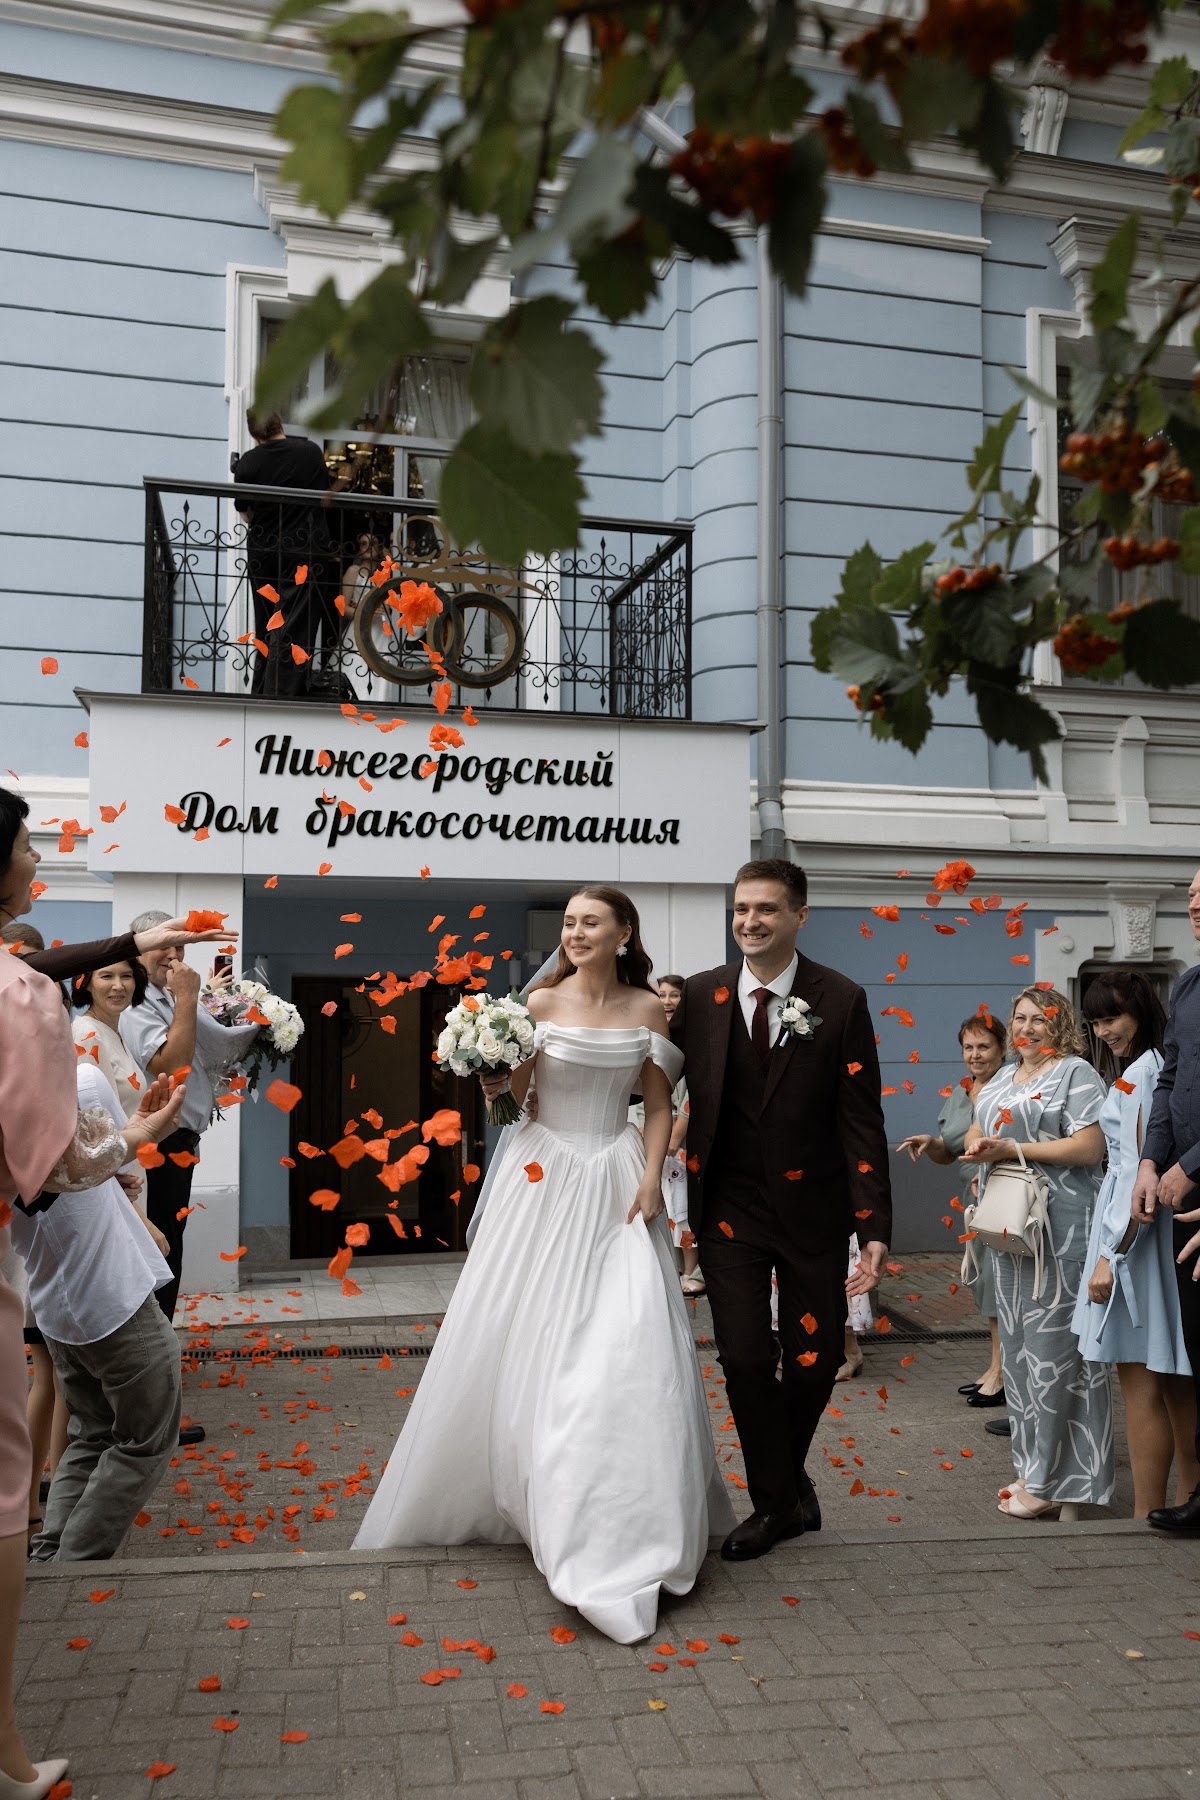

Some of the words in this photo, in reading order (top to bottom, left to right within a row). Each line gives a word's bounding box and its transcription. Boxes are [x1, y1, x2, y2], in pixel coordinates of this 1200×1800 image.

[254, 734, 614, 795] Нижегородский
[177, 791, 279, 835] Дом
[305, 796, 680, 848] бракосочетания
